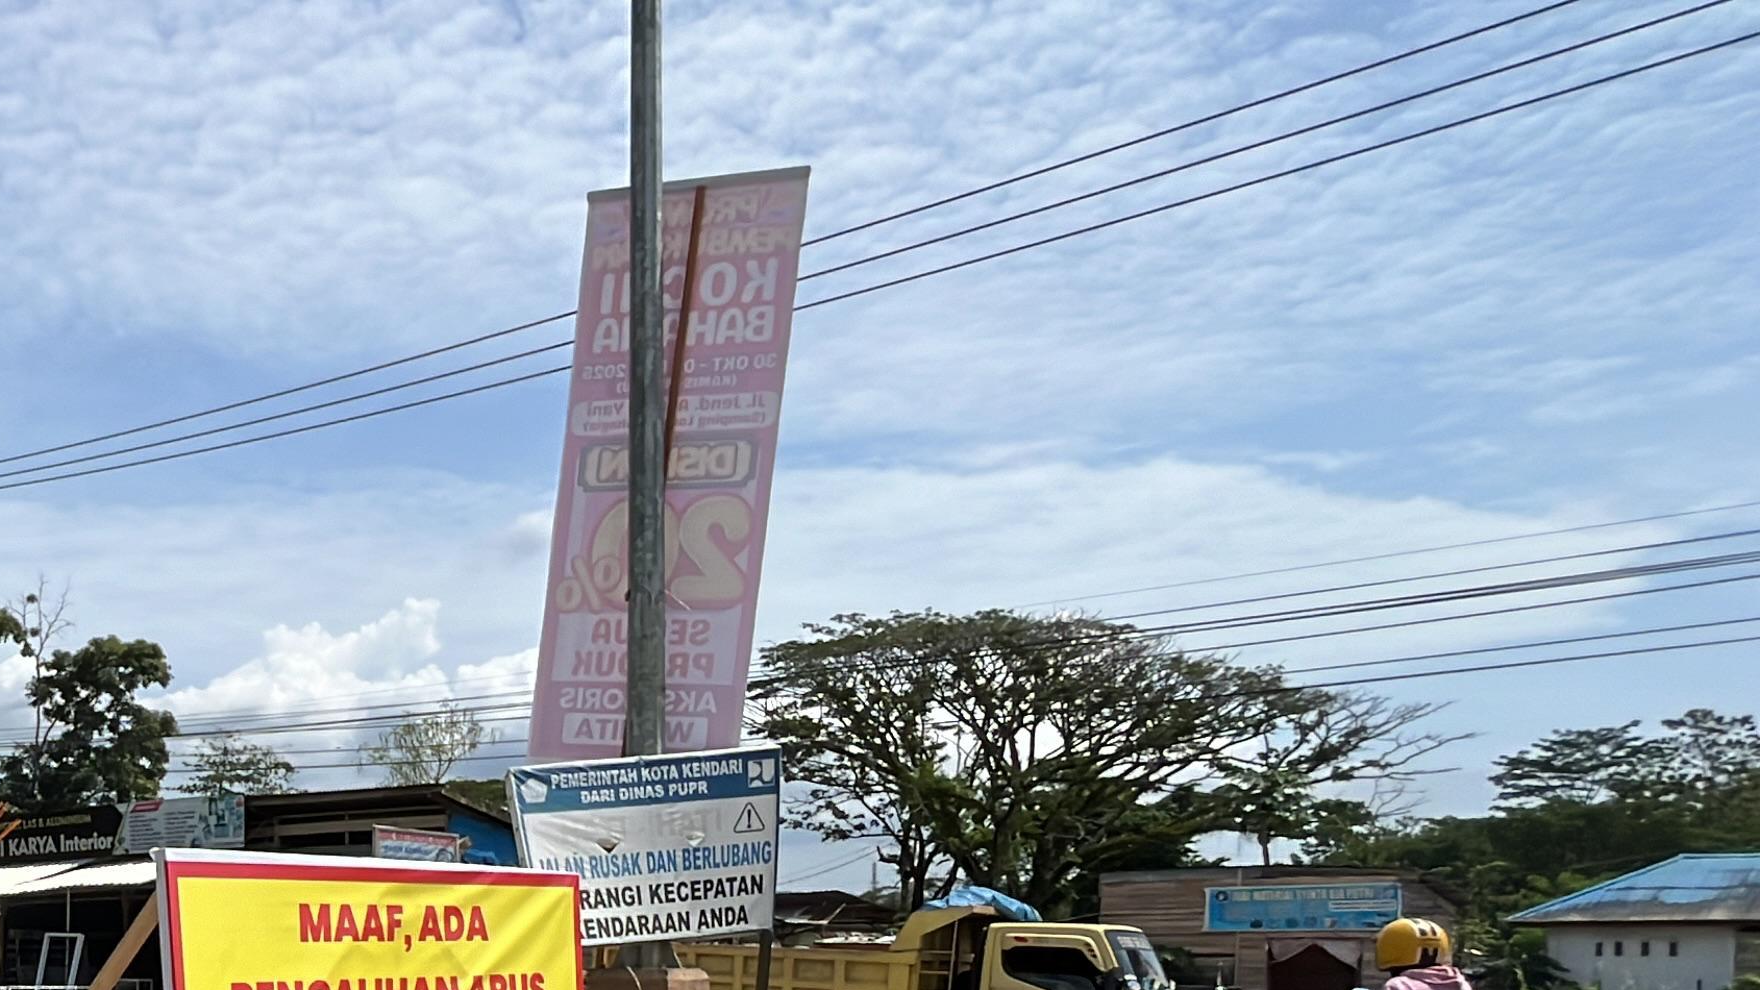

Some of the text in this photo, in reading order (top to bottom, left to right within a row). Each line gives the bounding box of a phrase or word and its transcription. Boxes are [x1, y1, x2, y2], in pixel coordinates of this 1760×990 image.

[551, 758, 743, 790] PEMERINTAH KOTA KENDARI
[580, 780, 709, 804] DARI DINAS PUPR
[8, 833, 58, 857] KARYA
[60, 831, 114, 853] Interior
[590, 851, 643, 880] RUSAK
[647, 848, 678, 874] DAN
[682, 840, 772, 871] BERLUBANG
[580, 874, 764, 911] RANGI KECEPATAN
[299, 904, 489, 952] MAAF, ADA
[697, 904, 749, 930] ANDA
